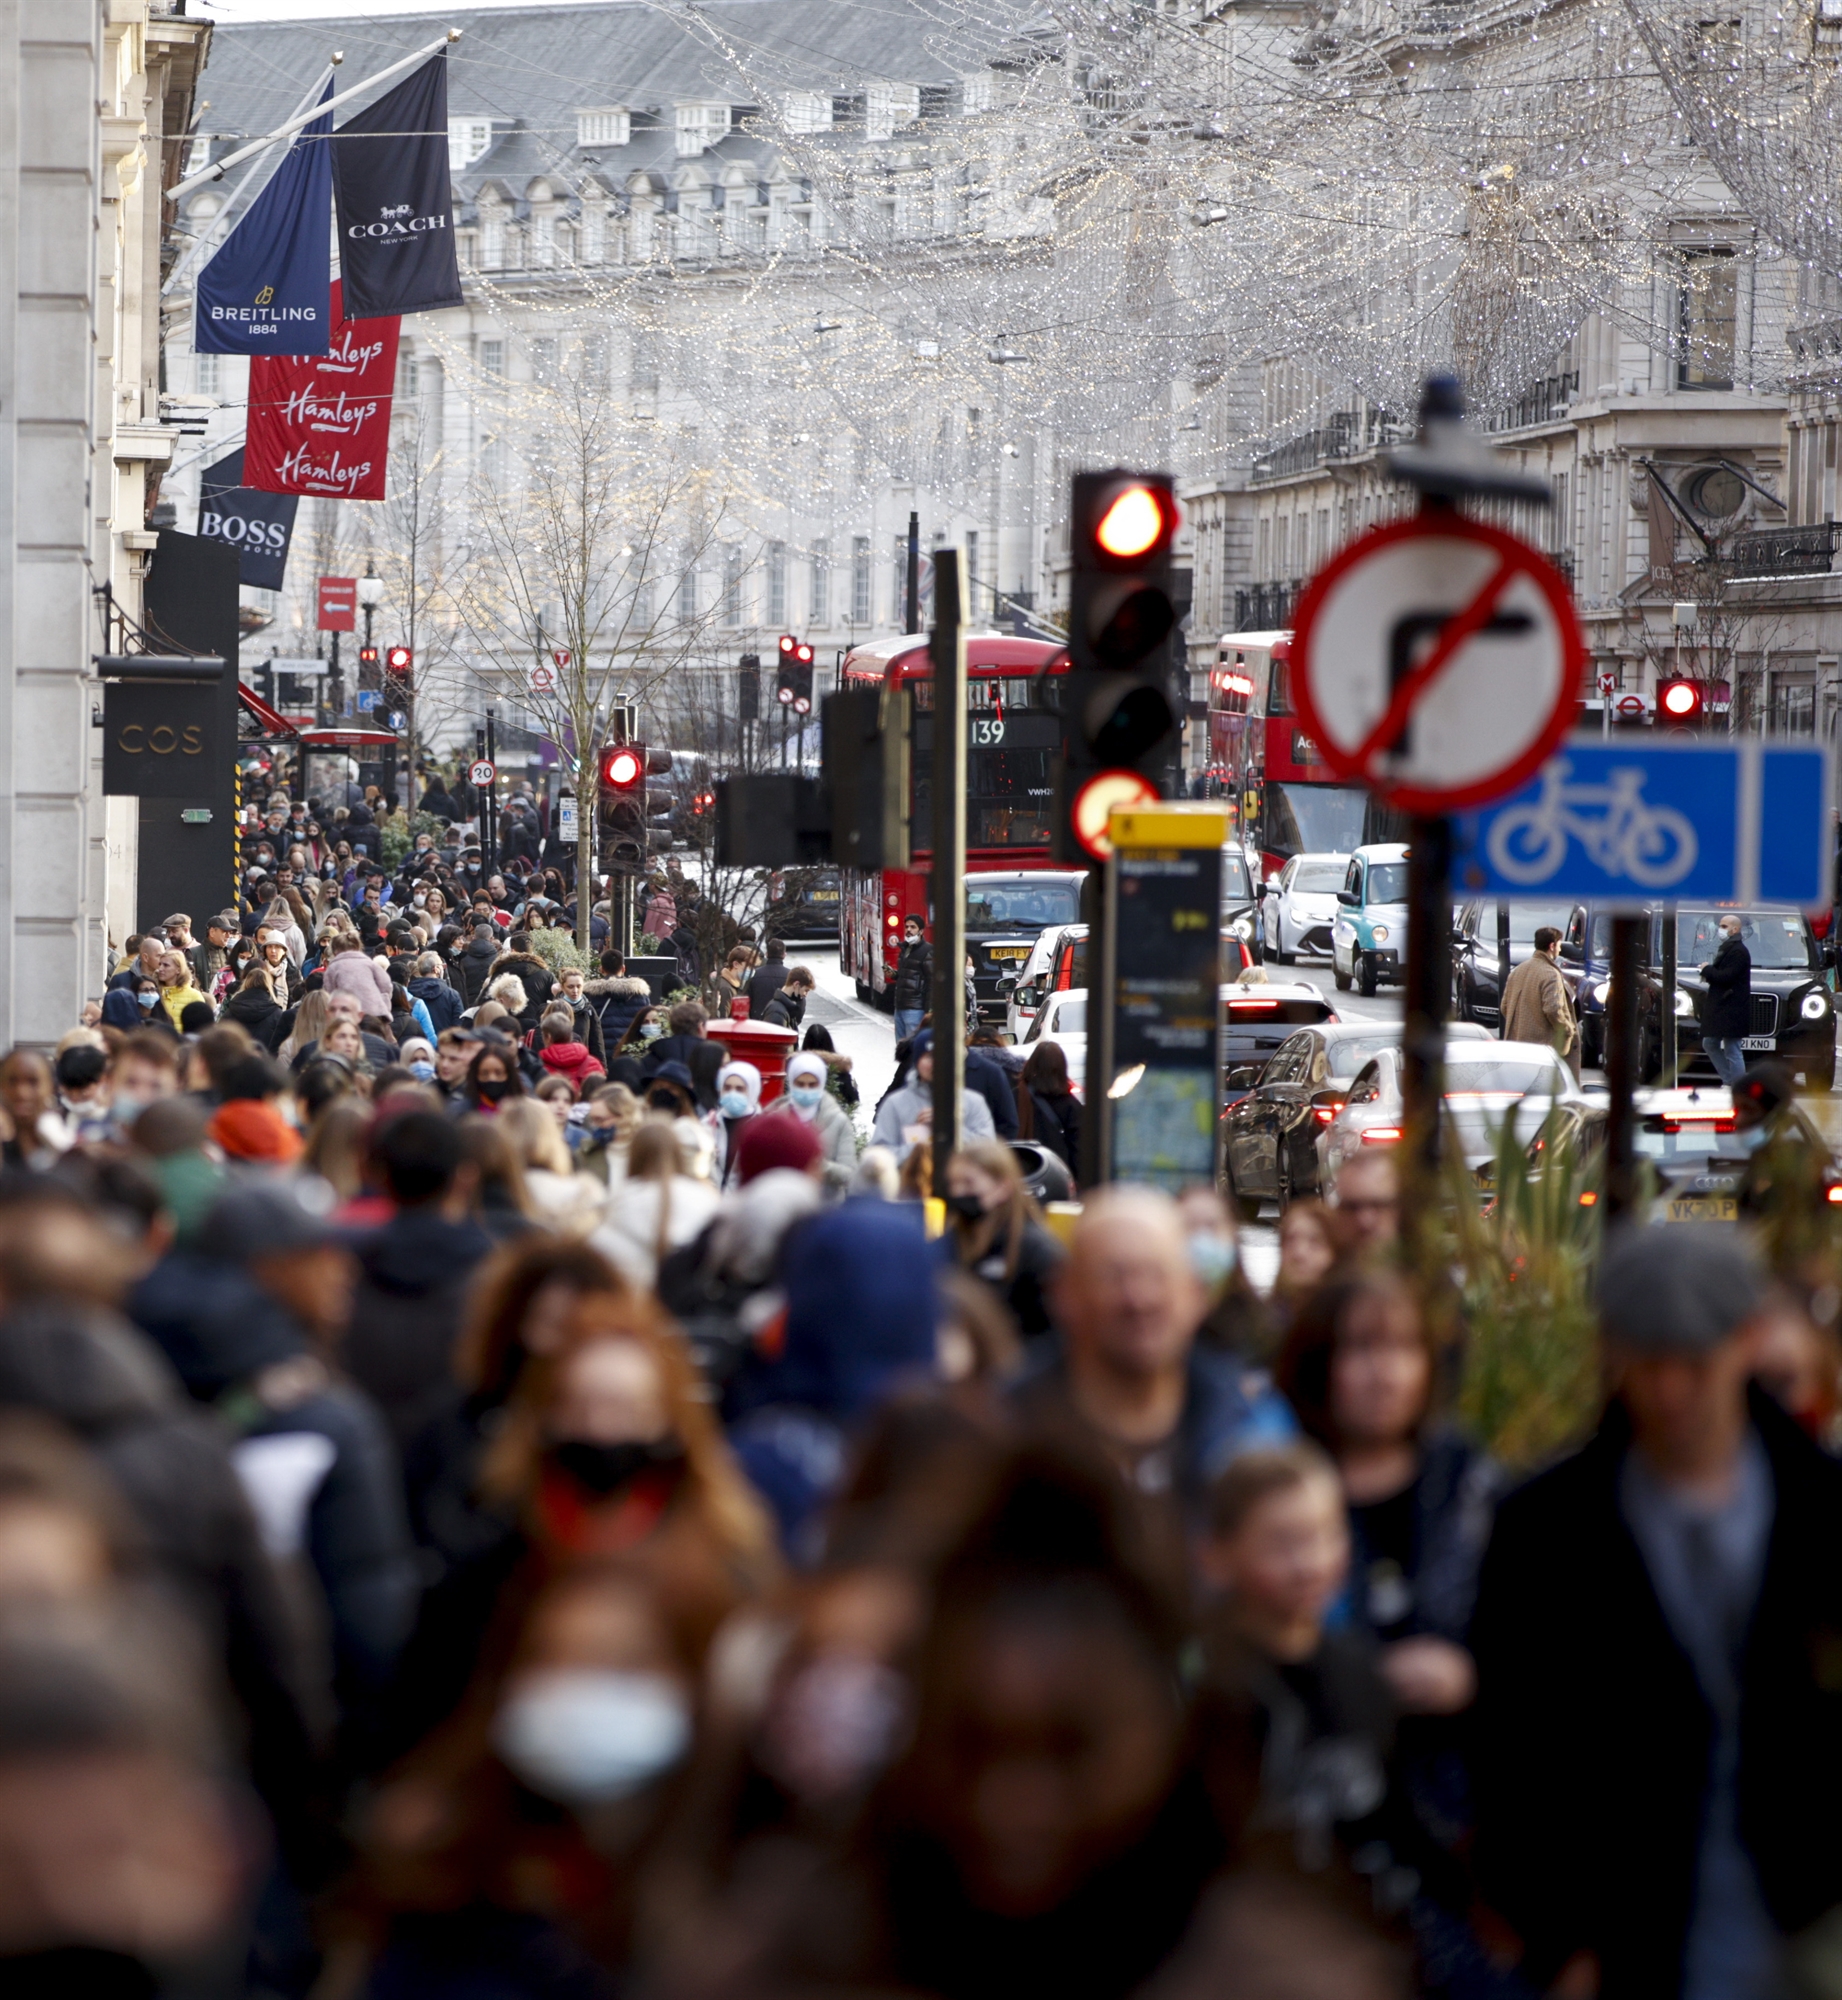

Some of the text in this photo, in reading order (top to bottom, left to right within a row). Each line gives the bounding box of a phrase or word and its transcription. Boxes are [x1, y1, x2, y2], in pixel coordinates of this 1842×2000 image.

[348, 214, 446, 239] COACH
[399, 234, 418, 243] YORK
[211, 306, 316, 321] BREITLING
[248, 324, 277, 334] 1884
[280, 381, 377, 436] Hamleys
[274, 441, 371, 495] Hamleys
[200, 511, 286, 548] BOSS
[243, 544, 282, 558] BOSS
[118, 725, 203, 755] COS
[972, 720, 1005, 744] 139
[1750, 1039, 1770, 1049] KNO
